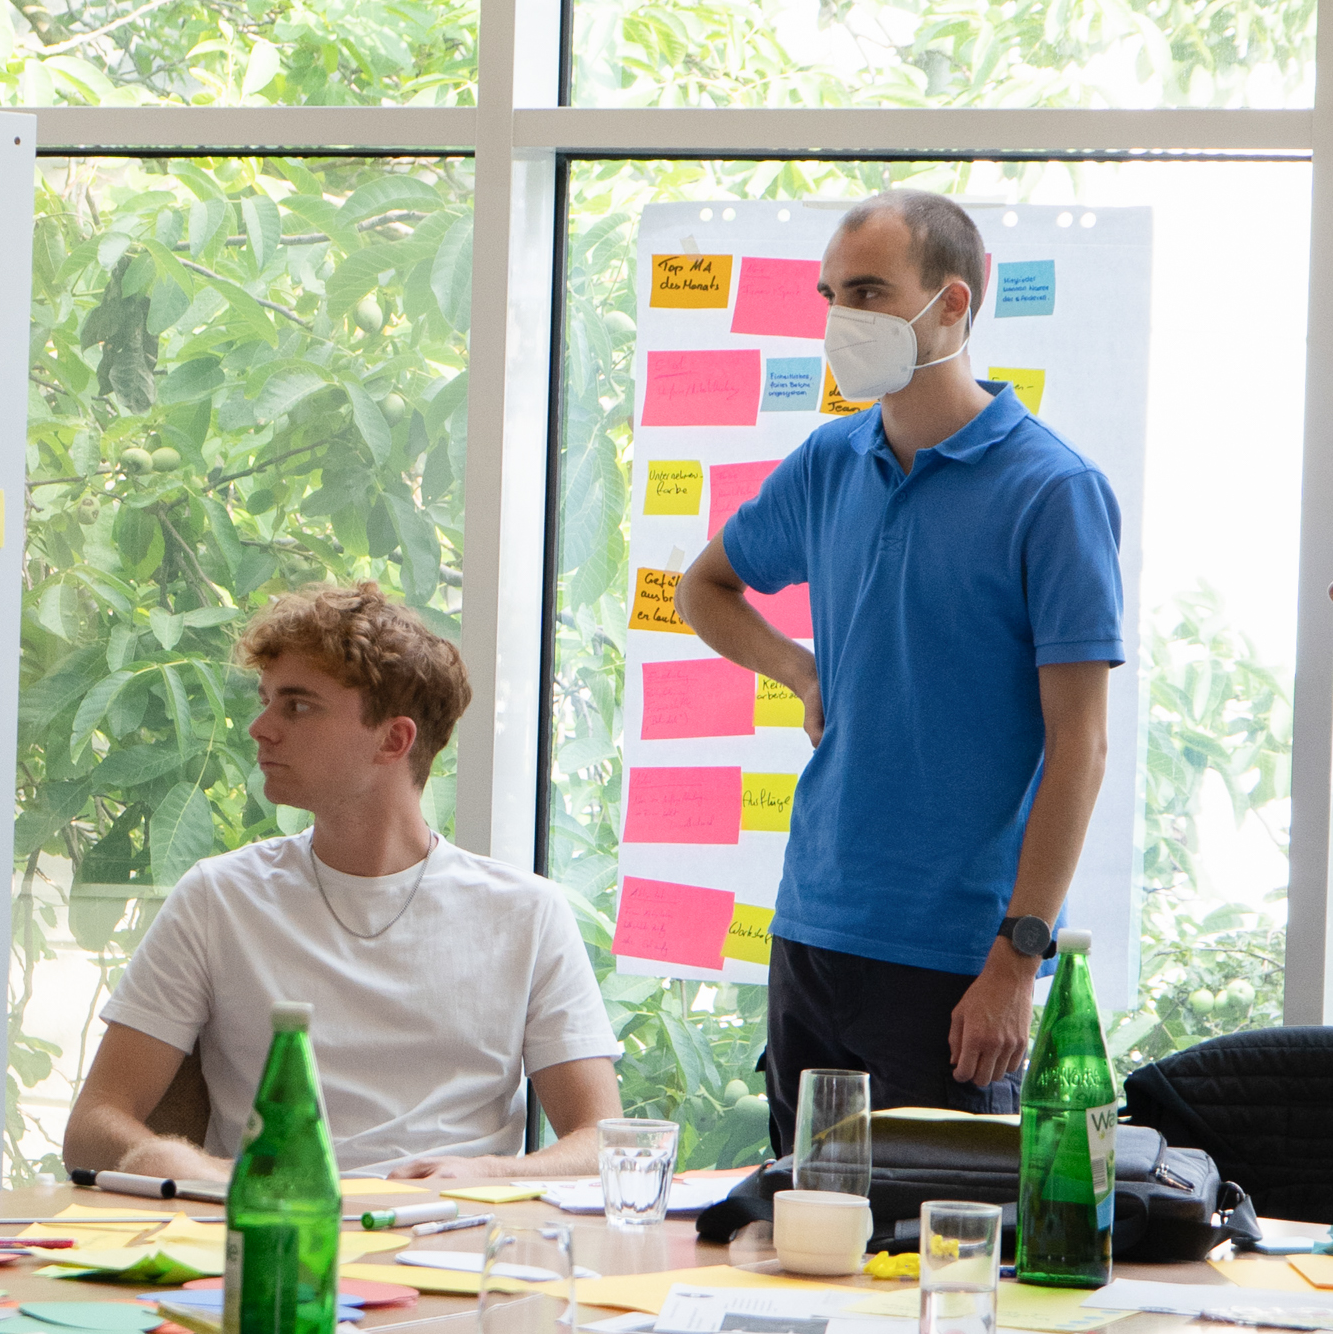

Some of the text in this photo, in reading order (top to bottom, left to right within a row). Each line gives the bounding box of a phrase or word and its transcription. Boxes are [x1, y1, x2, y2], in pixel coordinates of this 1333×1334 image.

[658, 256, 713, 277] Top MA
[659, 275, 721, 292] des Monats
[827, 399, 861, 413] Team
[640, 589, 675, 603] ausbr
[742, 788, 792, 813] Ausflüge
